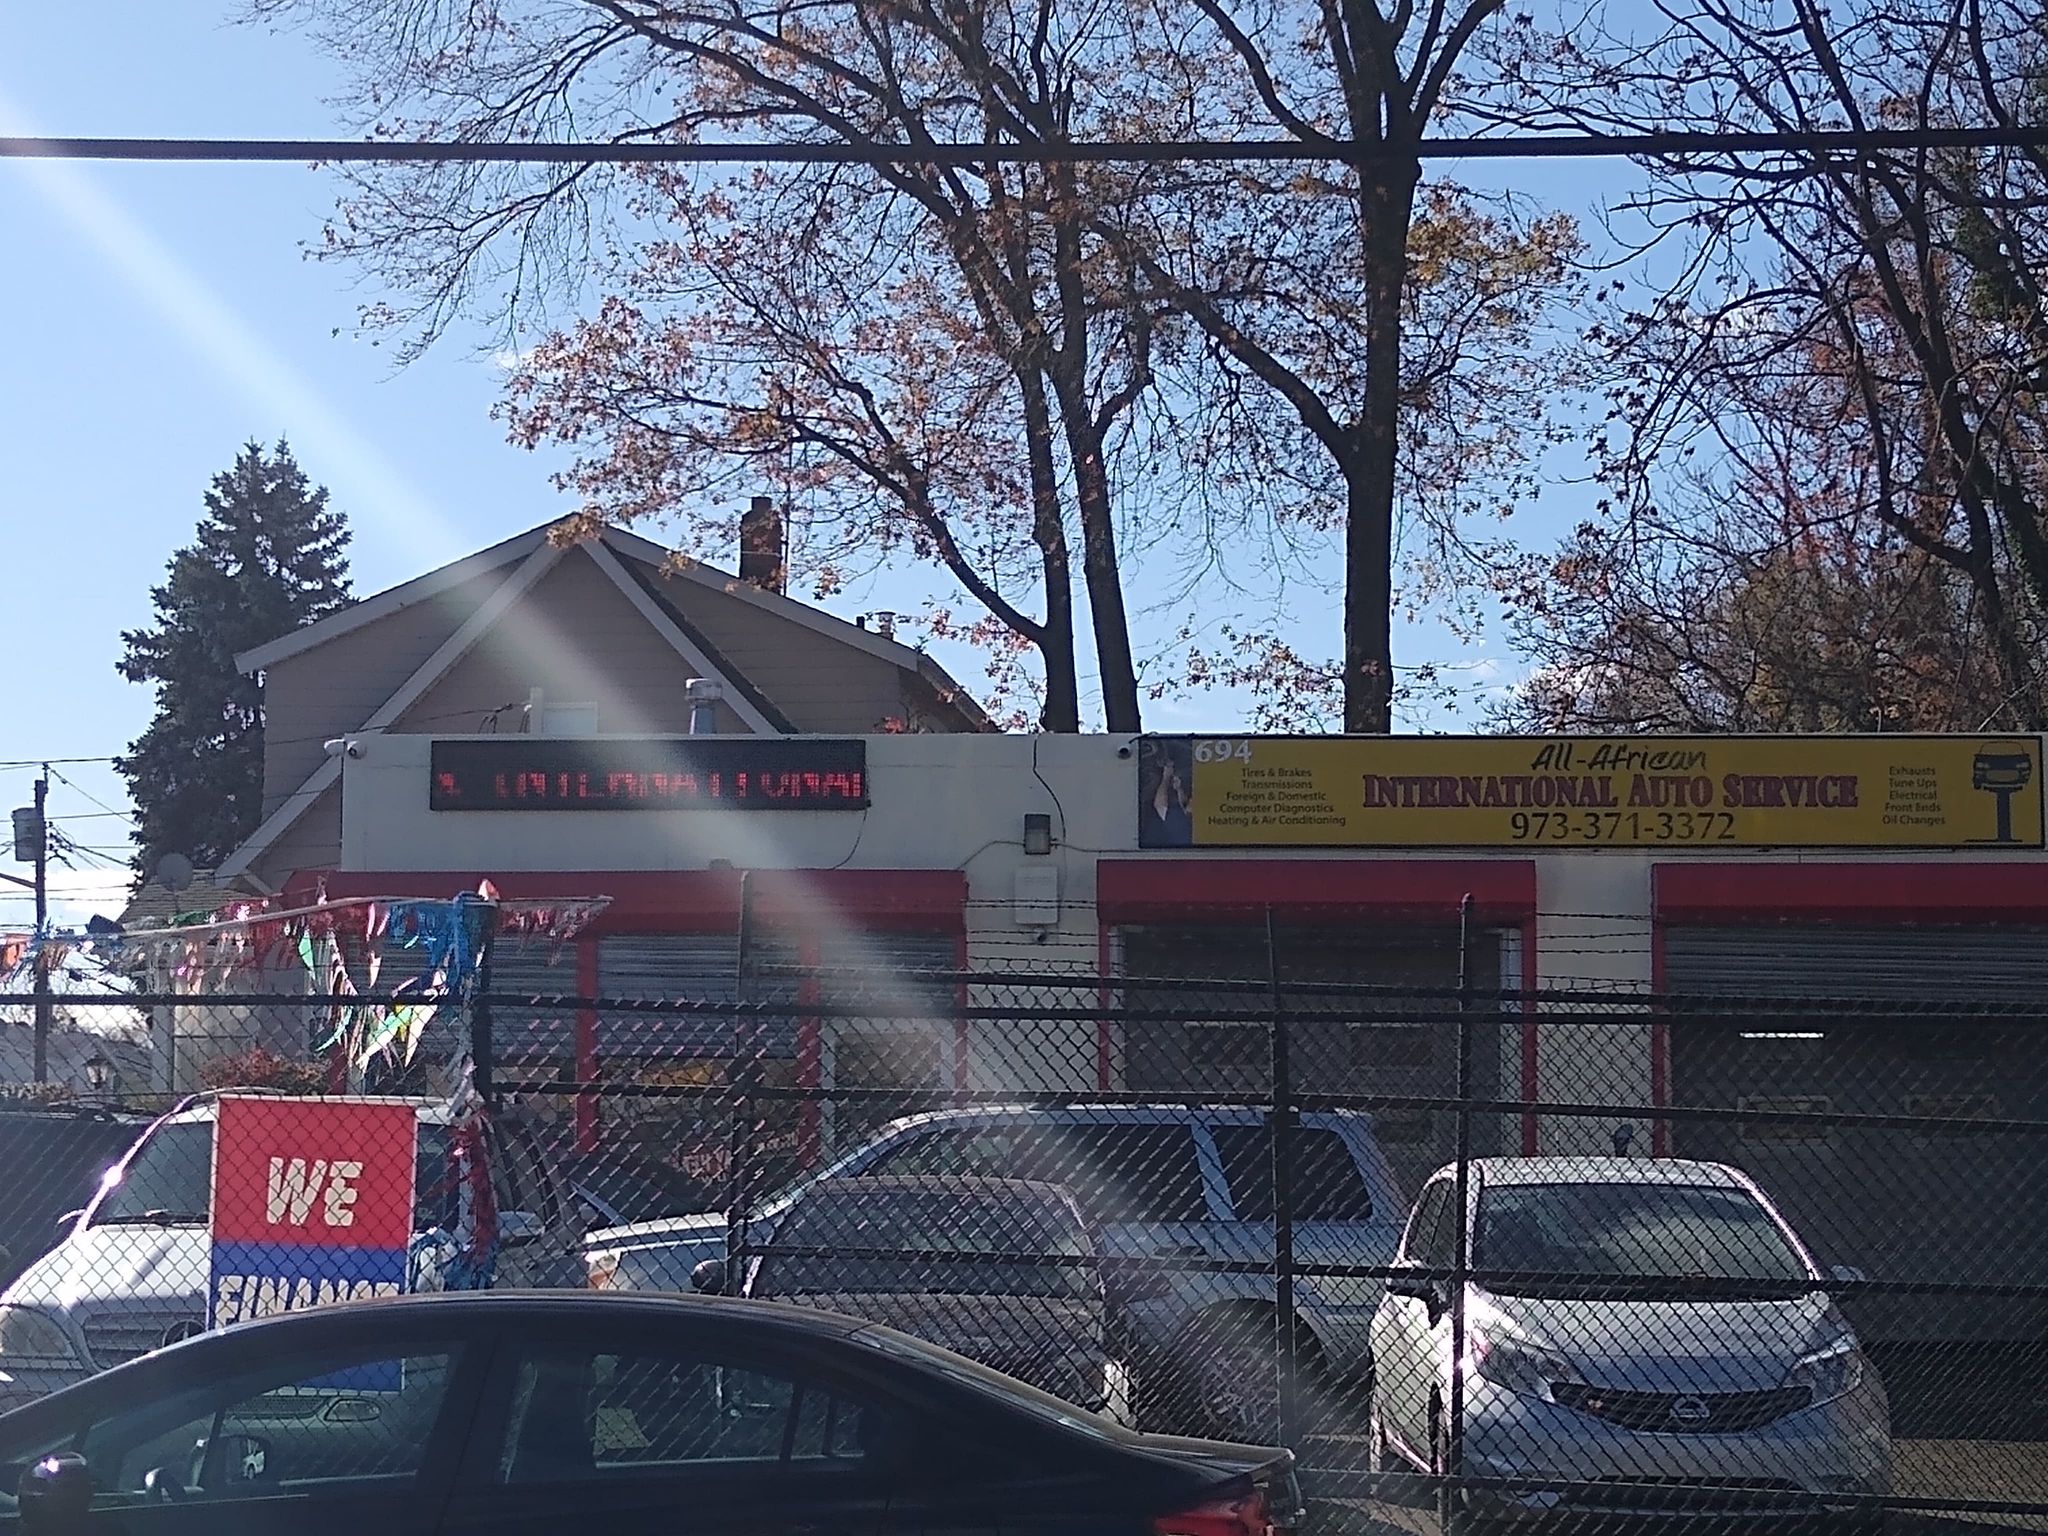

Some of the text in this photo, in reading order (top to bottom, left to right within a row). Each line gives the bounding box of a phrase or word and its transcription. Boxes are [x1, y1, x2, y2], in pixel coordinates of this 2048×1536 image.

[1195, 740, 1252, 764] 694
[1531, 743, 1706, 771] All-African
[1242, 768, 1312, 777] Tires & Brakes
[1889, 766, 1936, 776] Exhausts
[1242, 780, 1313, 789] Transmissions
[1889, 779, 1937, 789] Tune Ups
[1363, 774, 1859, 808] INTERNATIONAL AUTO SERVICE
[1889, 790, 1937, 800] Electrical
[1226, 792, 1327, 802] Foreign & Domestic
[1219, 803, 1334, 815] Computer Diagnostics
[1885, 803, 1941, 812] Front Ends
[1208, 816, 1346, 827] Heating & Air Conditioning
[1882, 814, 1946, 826] Oil Changes
[1511, 812, 1735, 840] 973-371-3372
[266, 1156, 363, 1226] WE
